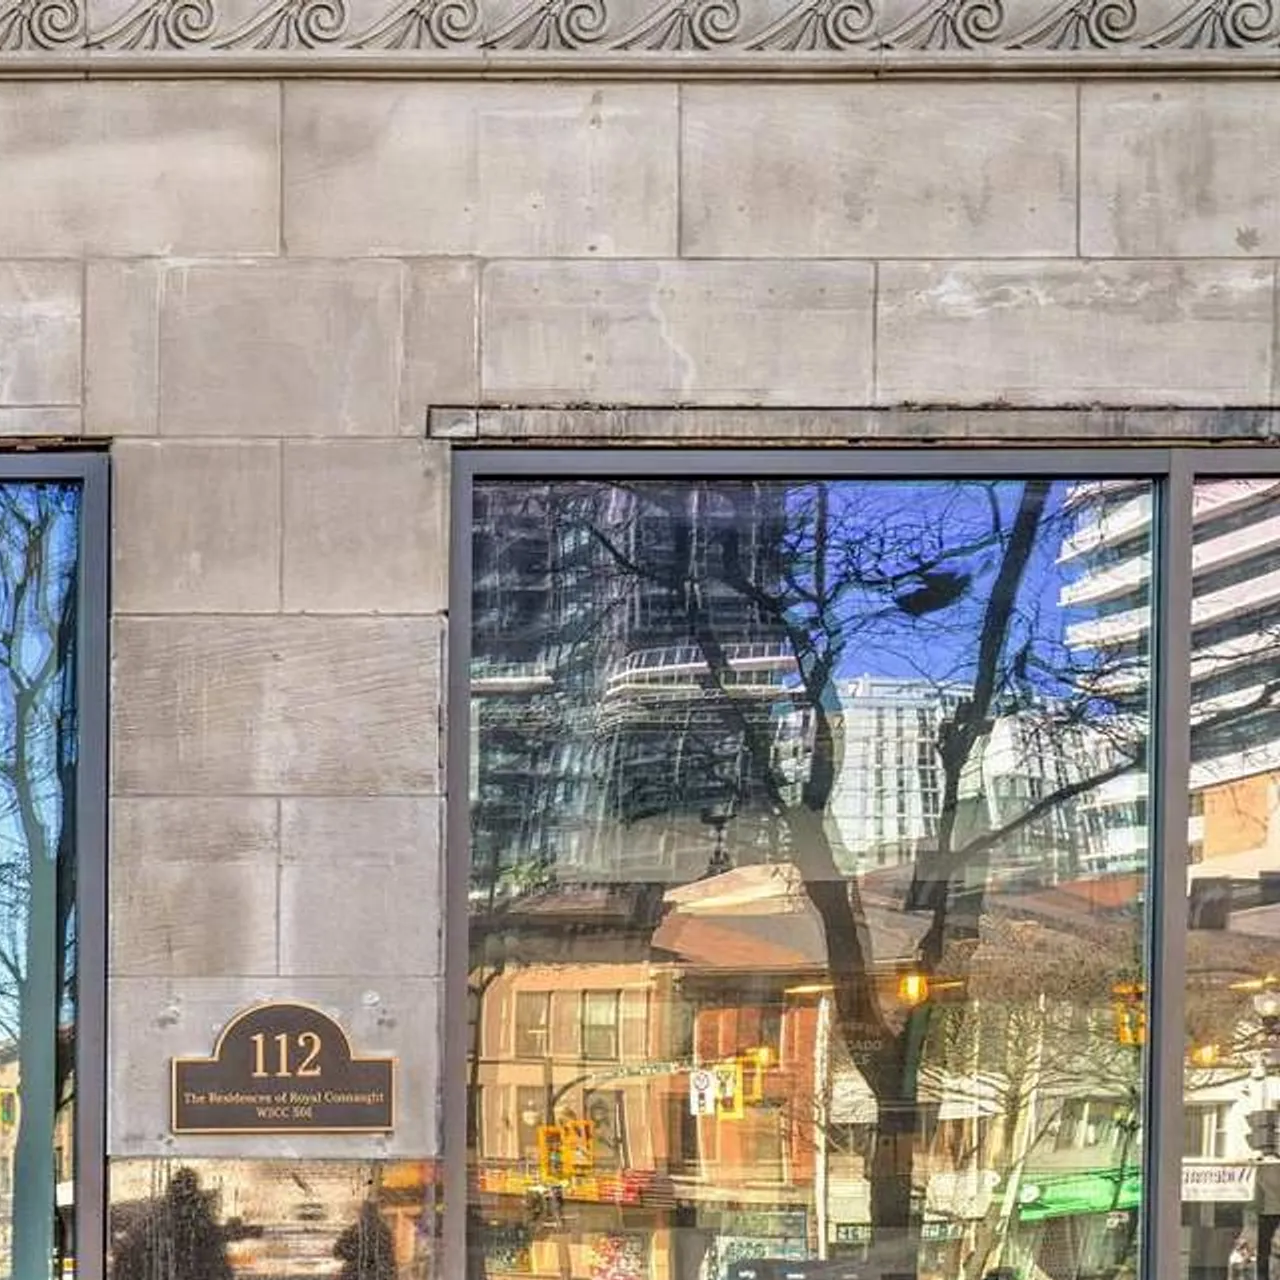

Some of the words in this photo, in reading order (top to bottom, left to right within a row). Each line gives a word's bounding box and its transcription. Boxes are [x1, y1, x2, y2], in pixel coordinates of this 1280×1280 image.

[251, 1031, 322, 1078] 112
[184, 1090, 206, 1105] The
[207, 1090, 271, 1105] Residences
[273, 1090, 288, 1104] of
[289, 1090, 321, 1107] Royal
[323, 1090, 384, 1106] Connaught
